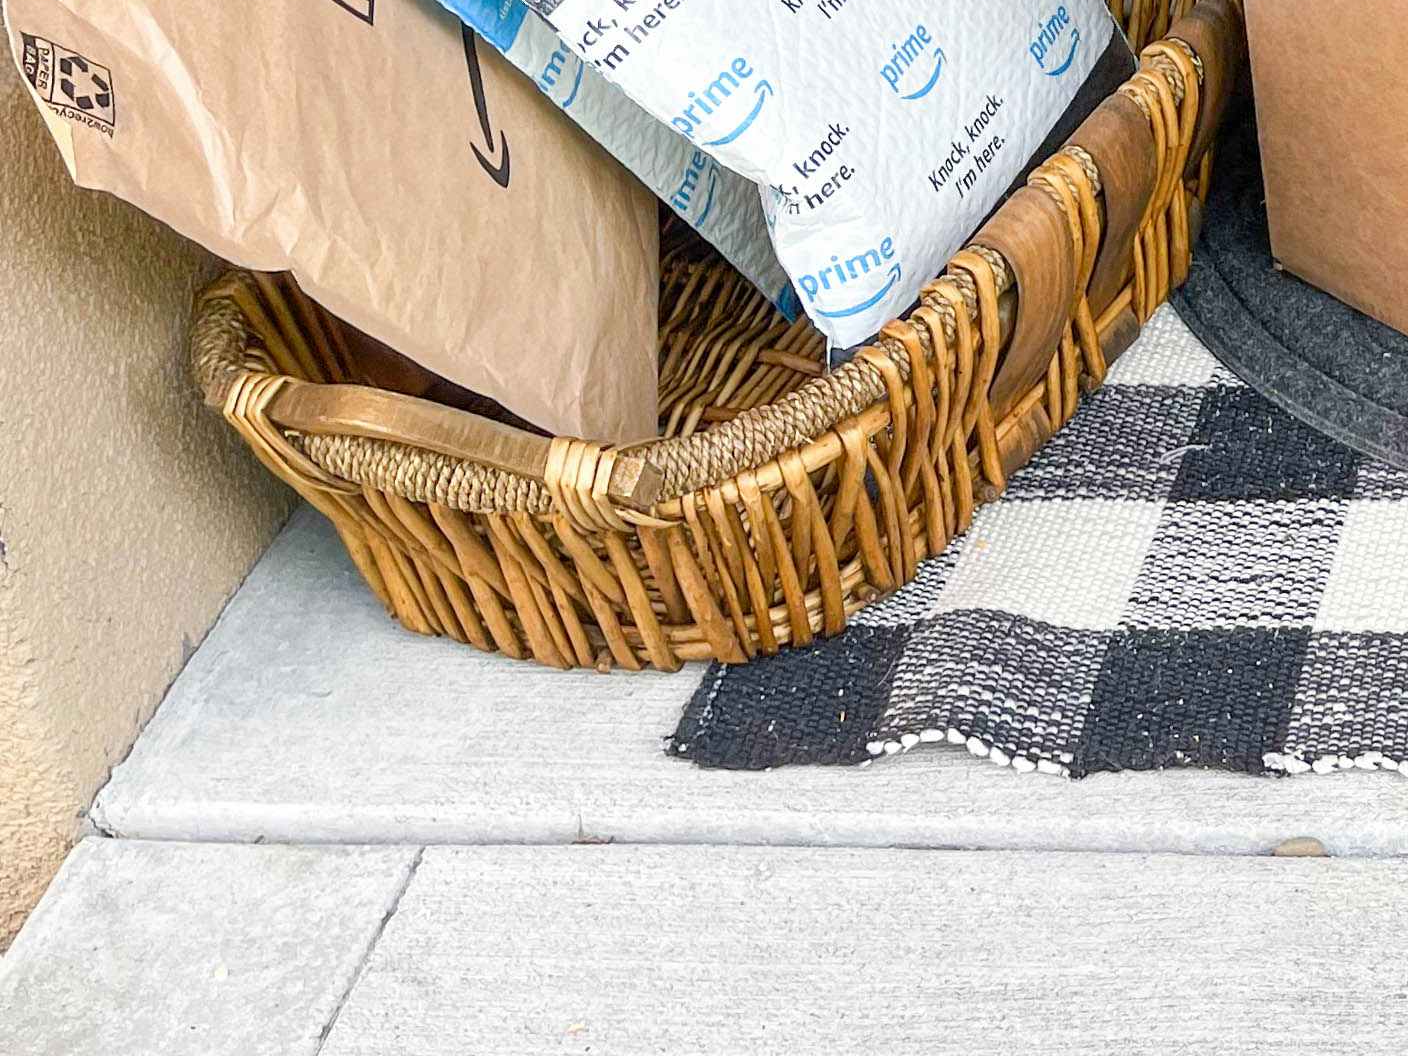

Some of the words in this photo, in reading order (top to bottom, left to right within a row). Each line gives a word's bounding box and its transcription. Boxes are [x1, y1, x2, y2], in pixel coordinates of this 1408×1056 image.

[38, 46, 50, 90] PAPER
[879, 23, 932, 93] prime
[1029, 4, 1070, 70] prime
[671, 56, 754, 140] prime
[791, 121, 851, 180] knock.
[927, 140, 971, 193] Knock,
[963, 94, 1005, 143] knock.
[954, 167, 977, 199] I'm
[973, 134, 1006, 175] here.
[804, 164, 856, 210] here.
[798, 235, 896, 303] prime
